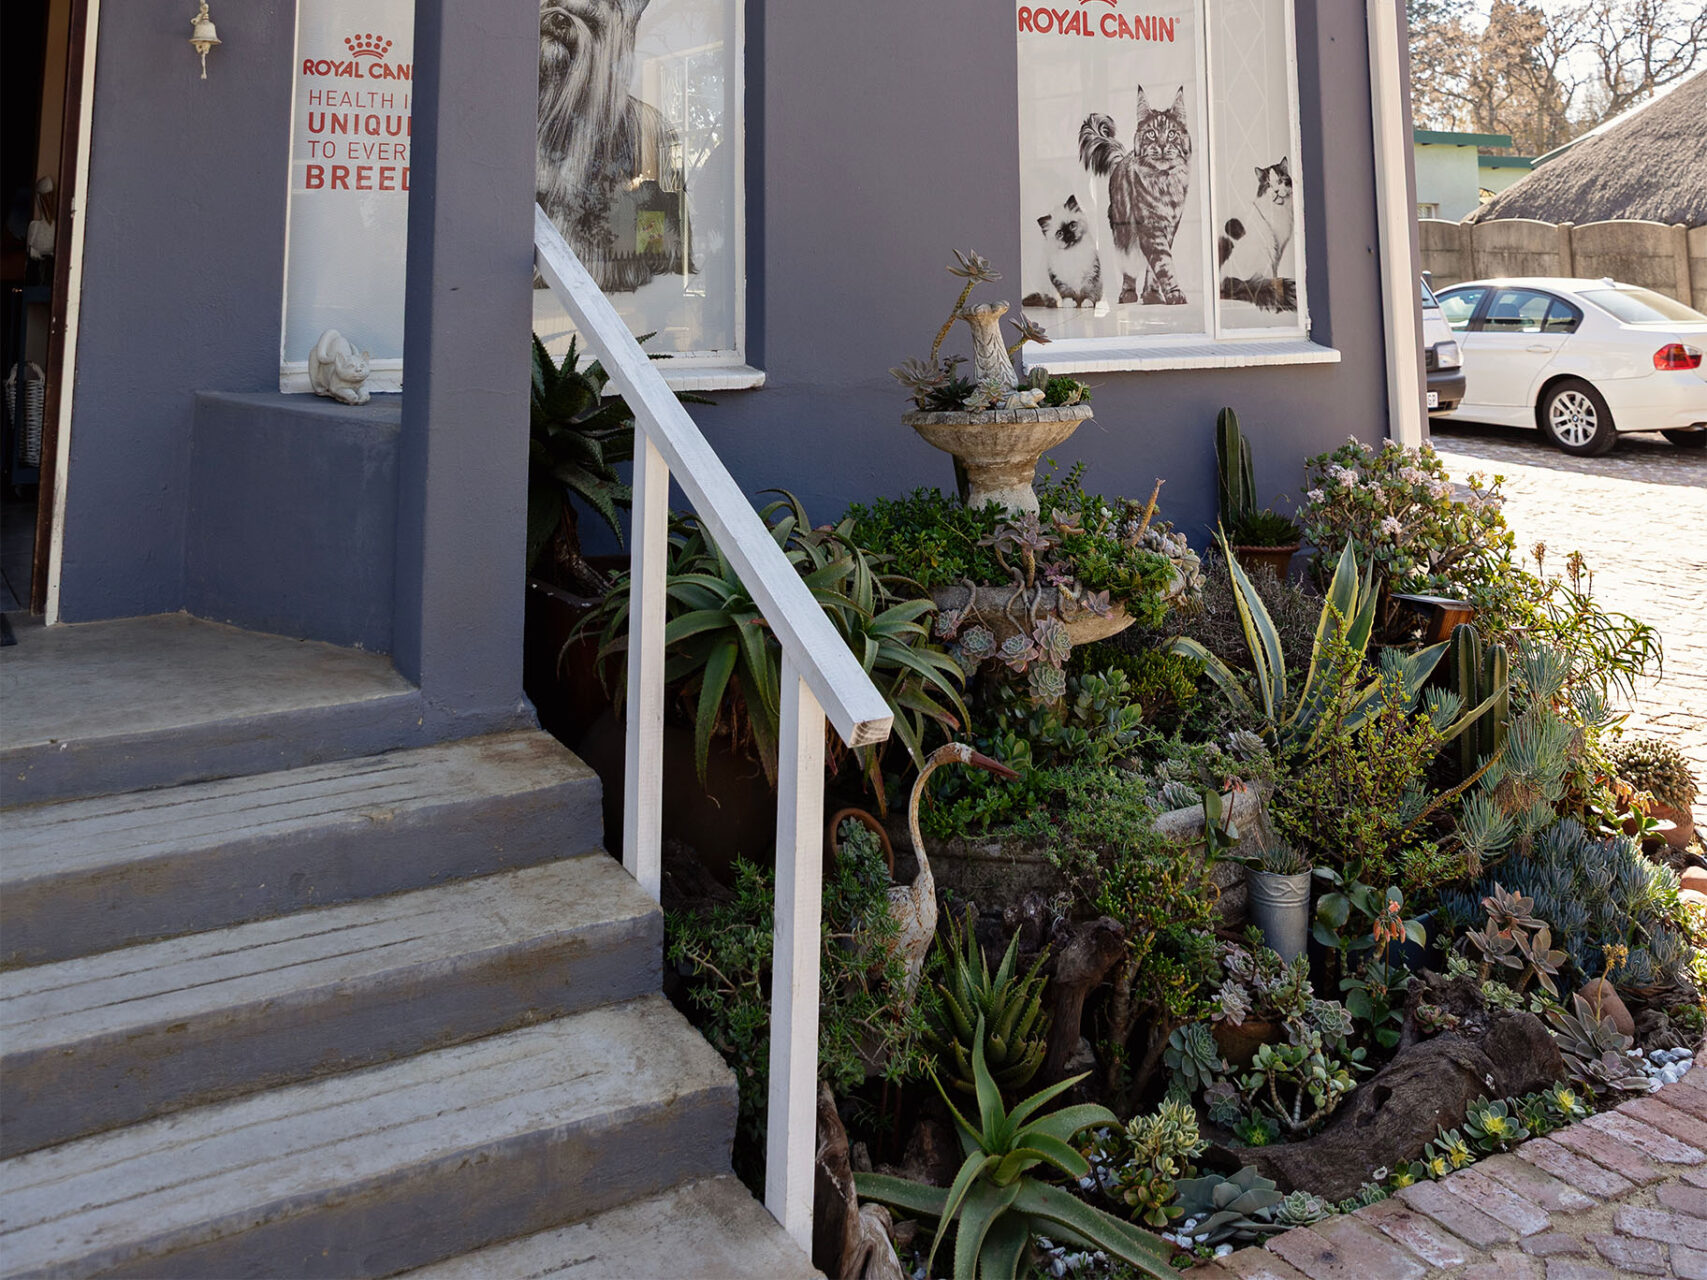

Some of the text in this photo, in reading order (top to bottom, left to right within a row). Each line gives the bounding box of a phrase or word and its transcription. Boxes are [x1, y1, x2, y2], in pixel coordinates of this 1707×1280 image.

[1018, 6, 1175, 43] ROYAL CANIN
[303, 59, 364, 79] ROYAL
[309, 89, 394, 109] HEALTH
[308, 140, 411, 161] TO EVER
